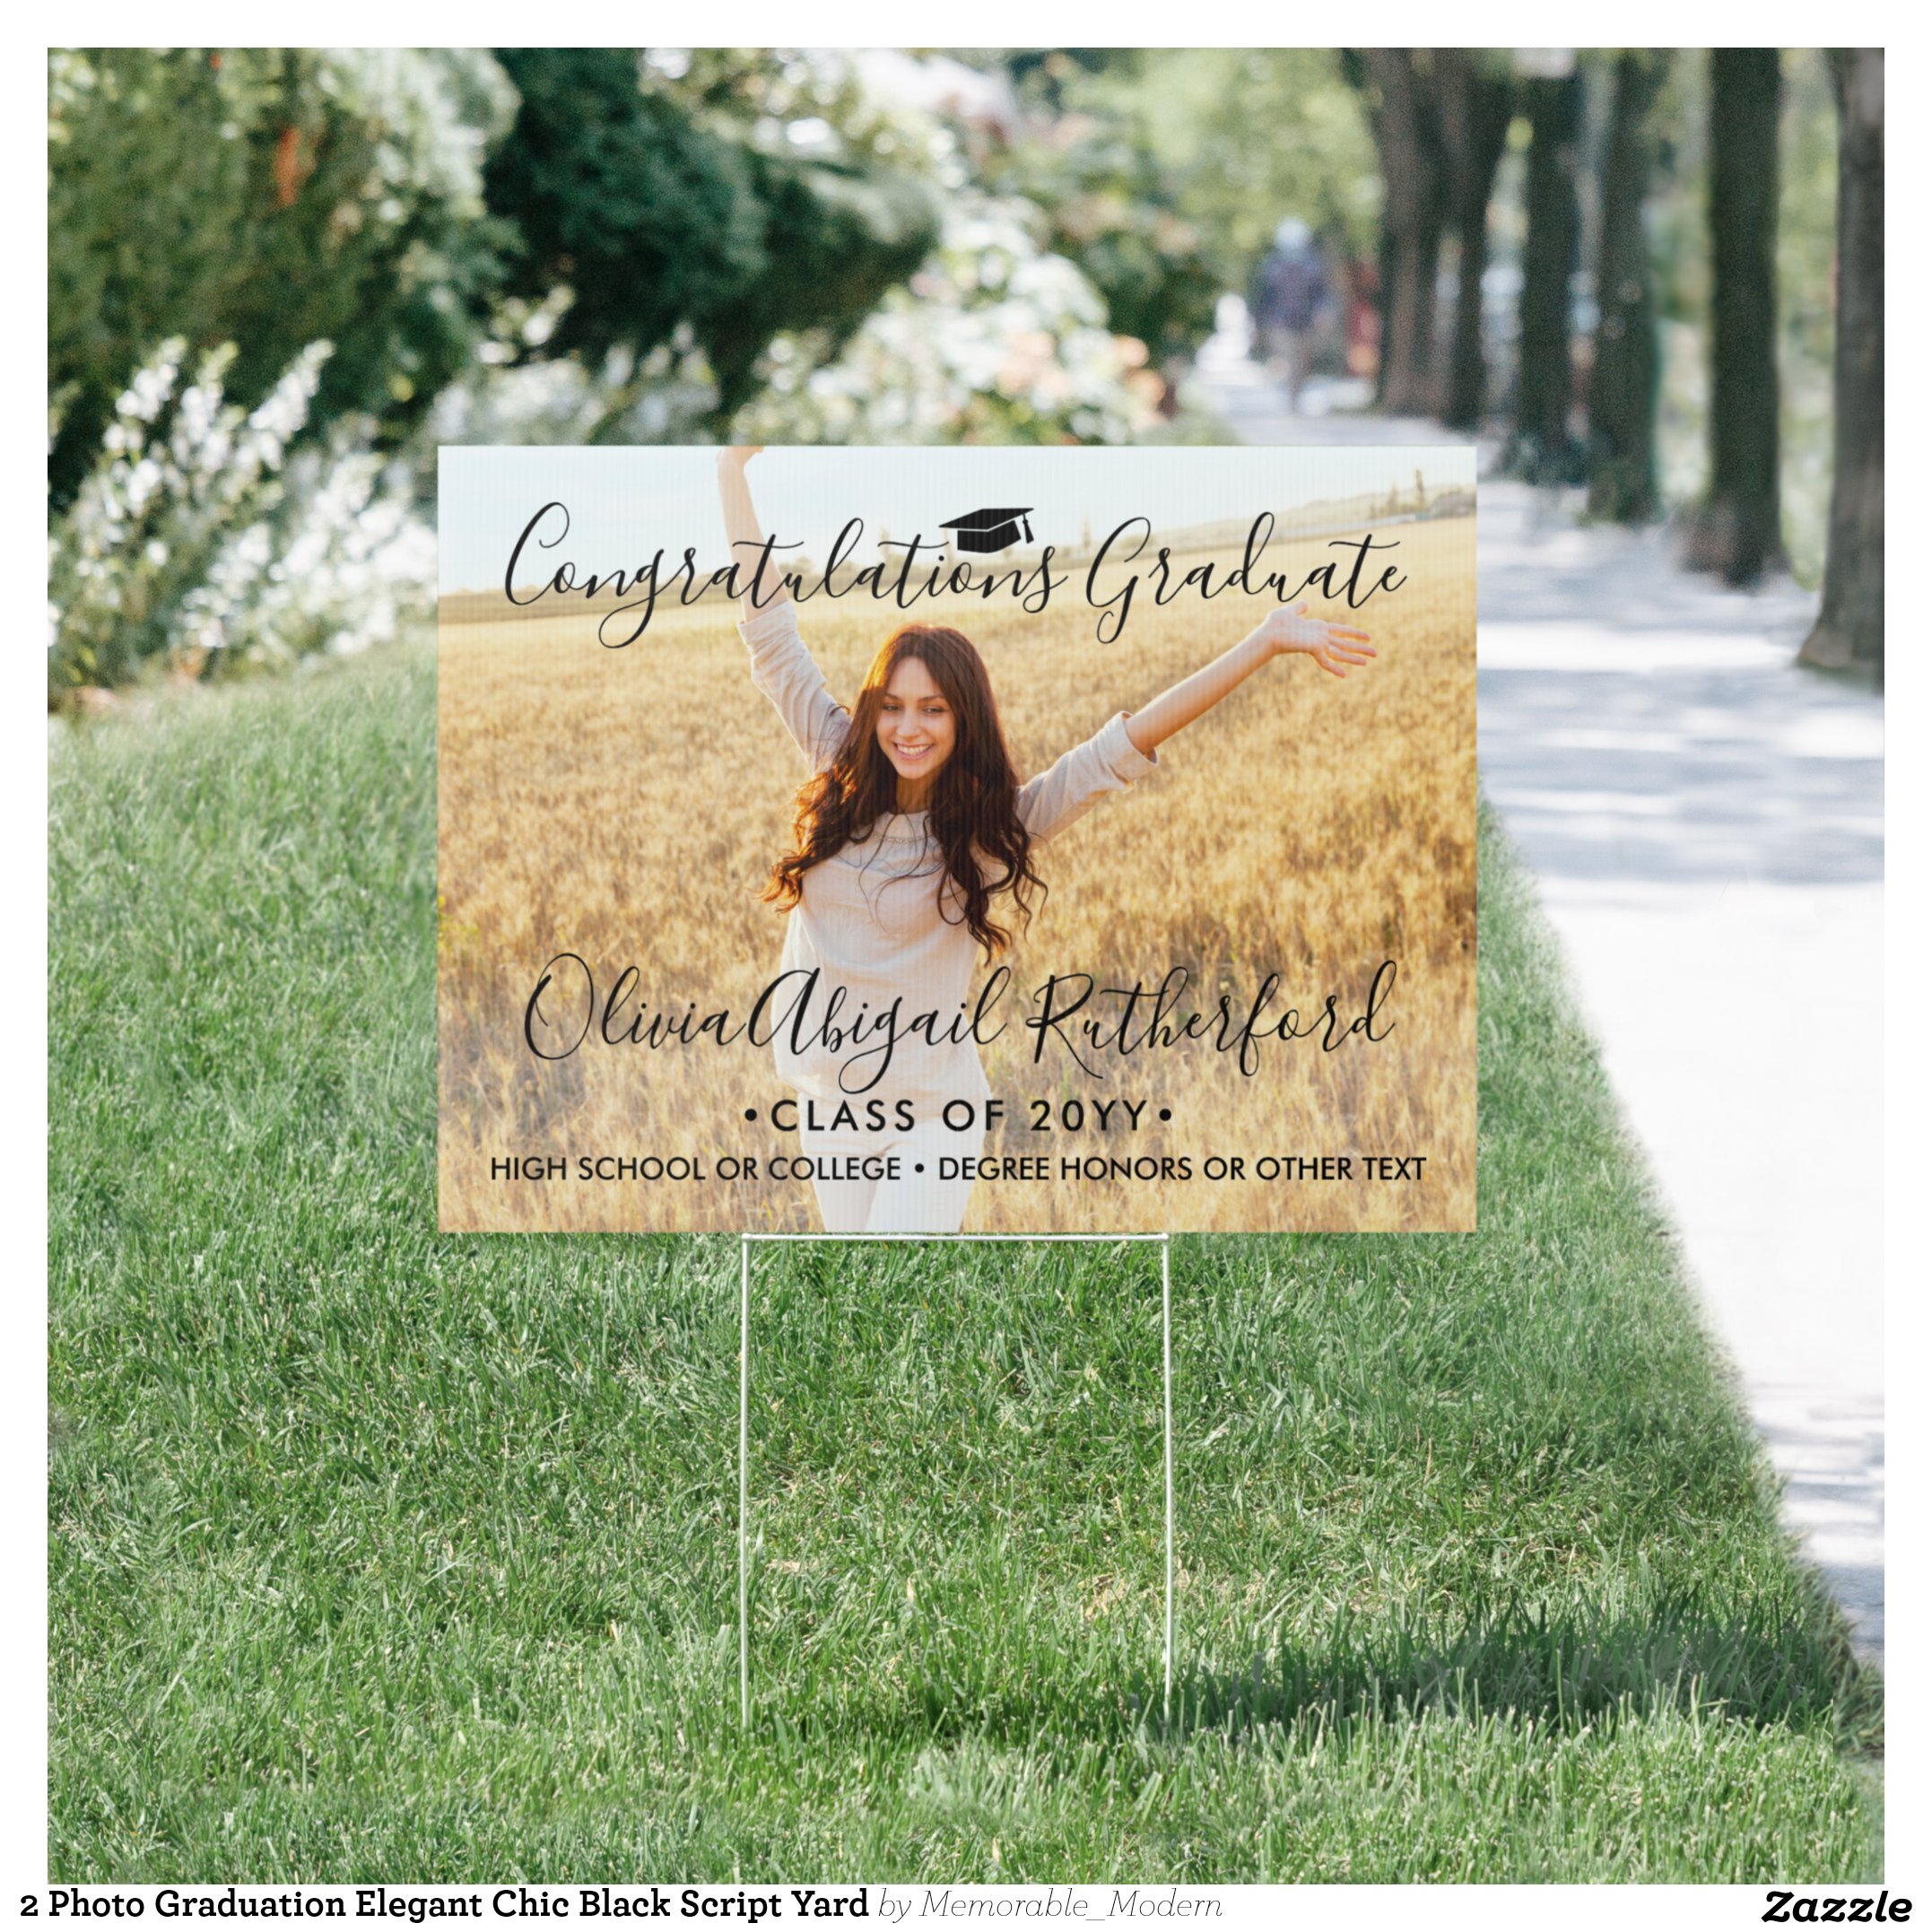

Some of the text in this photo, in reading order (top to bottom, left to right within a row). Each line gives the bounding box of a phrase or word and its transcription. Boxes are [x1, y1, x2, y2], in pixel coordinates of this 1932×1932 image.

[504, 500, 1408, 649] Congratulations Graduate
[523, 952, 1397, 1094] Olivia Abigail Rutherford
[942, 1099, 1005, 1133] OF
[491, 1156, 567, 1181] HIGH
[578, 1156, 706, 1181] SCHOOL
[716, 1156, 759, 1181] OR
[769, 1156, 901, 1181] COLLEGE
[938, 1156, 1049, 1181] DEGREE
[1060, 1156, 1193, 1181] HONORS
[1203, 1156, 1246, 1181] OR
[1256, 1156, 1353, 1181] OTHER
[1362, 1156, 1426, 1181] TEXT
